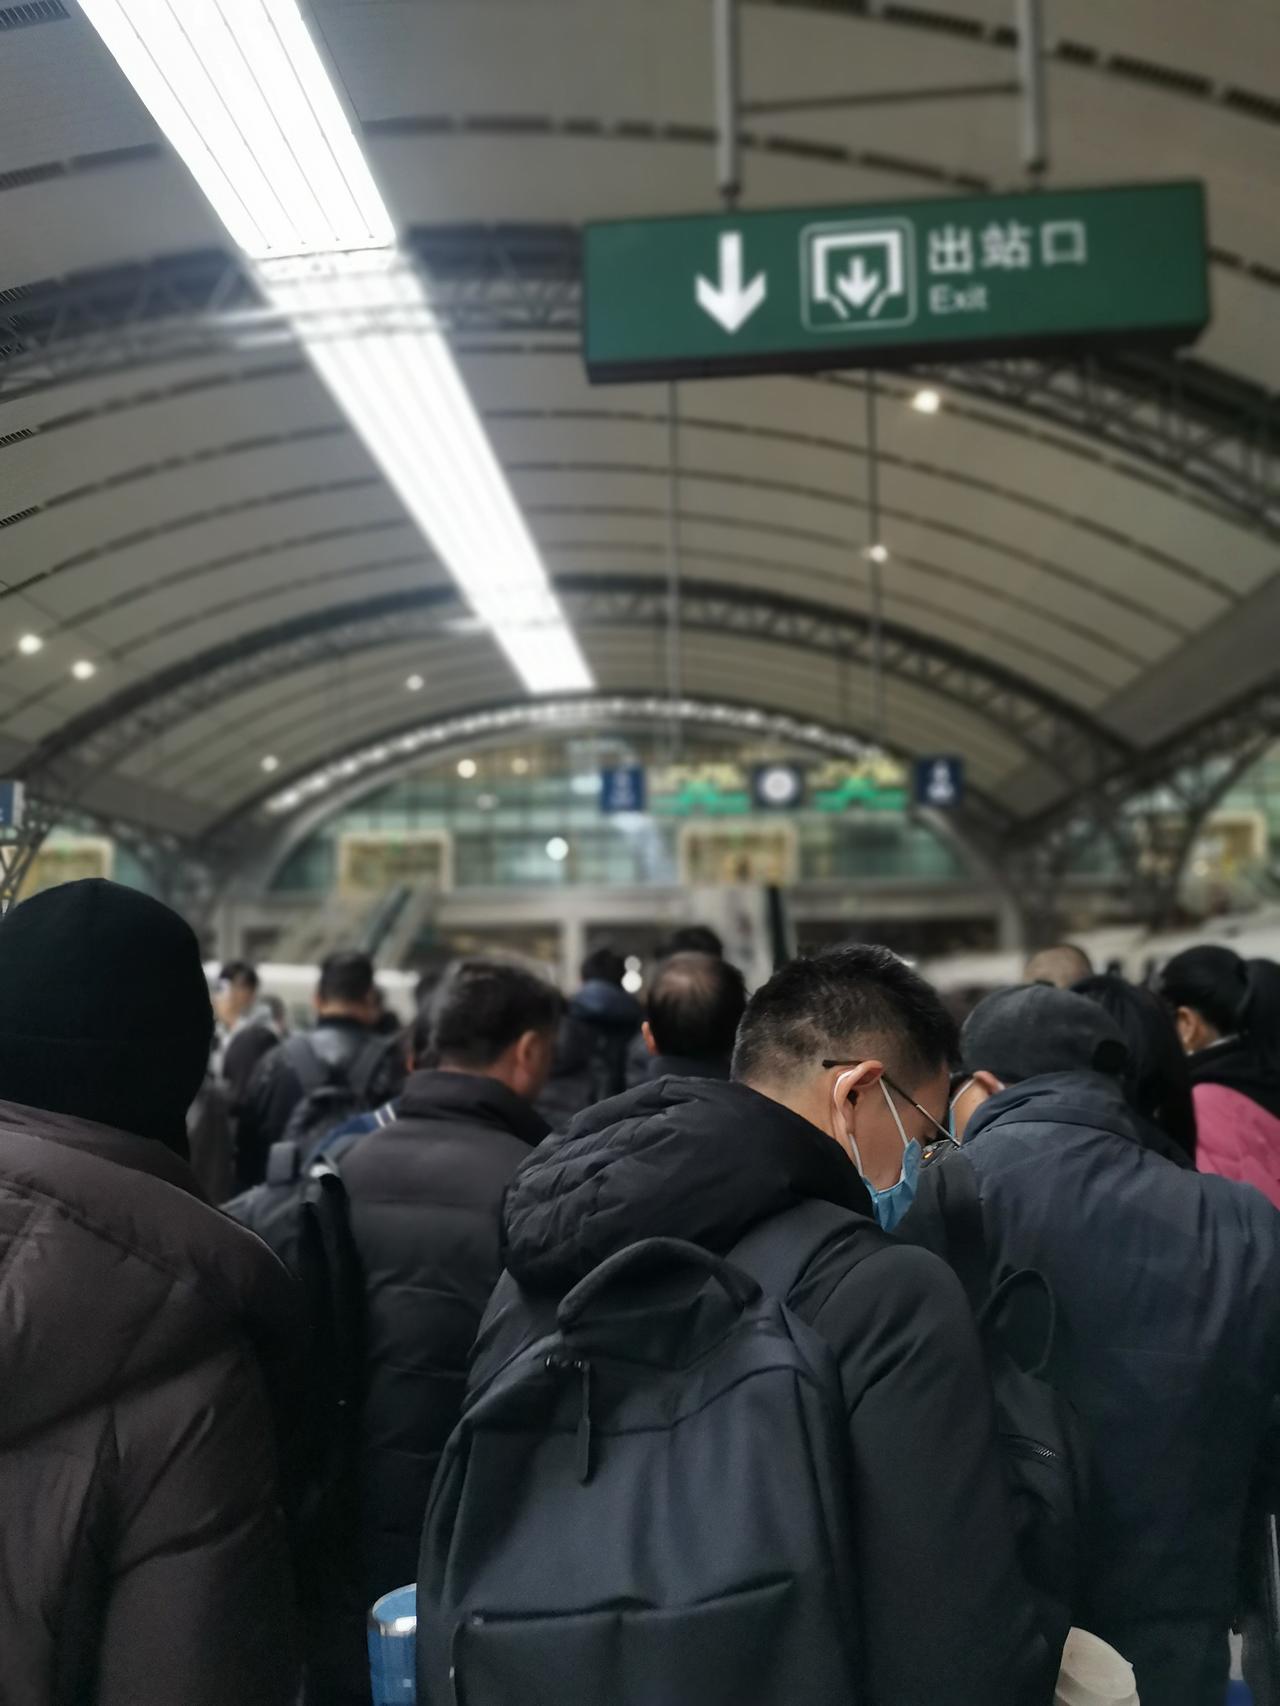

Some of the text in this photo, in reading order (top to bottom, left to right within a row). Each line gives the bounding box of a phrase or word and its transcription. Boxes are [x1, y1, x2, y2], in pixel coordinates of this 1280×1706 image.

[928, 220, 1087, 274] 出站口
[929, 284, 988, 314] Exit
